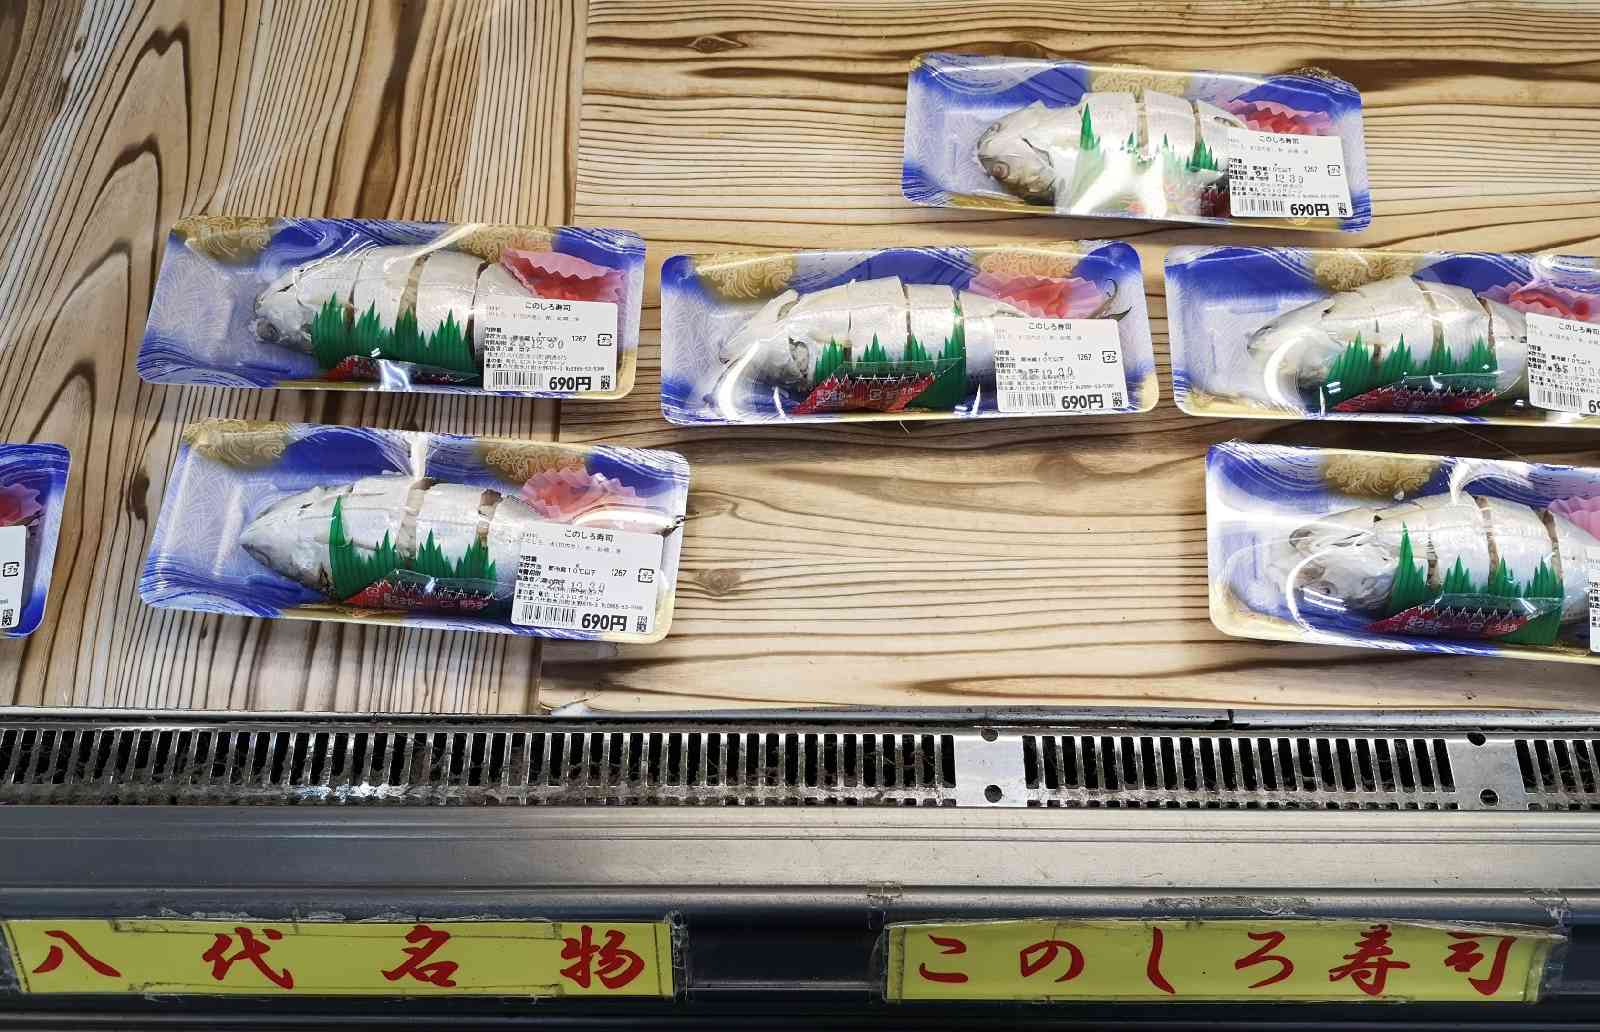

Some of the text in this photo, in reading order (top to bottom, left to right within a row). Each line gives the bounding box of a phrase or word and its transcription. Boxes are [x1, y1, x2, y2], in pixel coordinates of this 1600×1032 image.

[1290, 203, 1330, 216] 690円
[525, 302, 571, 311] このしろ寿司
[1028, 322, 1072, 331] このしろ寿司
[549, 376, 592, 391] 690円
[1061, 394, 1104, 409] 690円
[564, 530, 614, 542] このしろ寿司
[581, 613, 628, 631] 690円
[32, 924, 646, 989] 八代名物
[919, 924, 1517, 995] このしろ寿司
